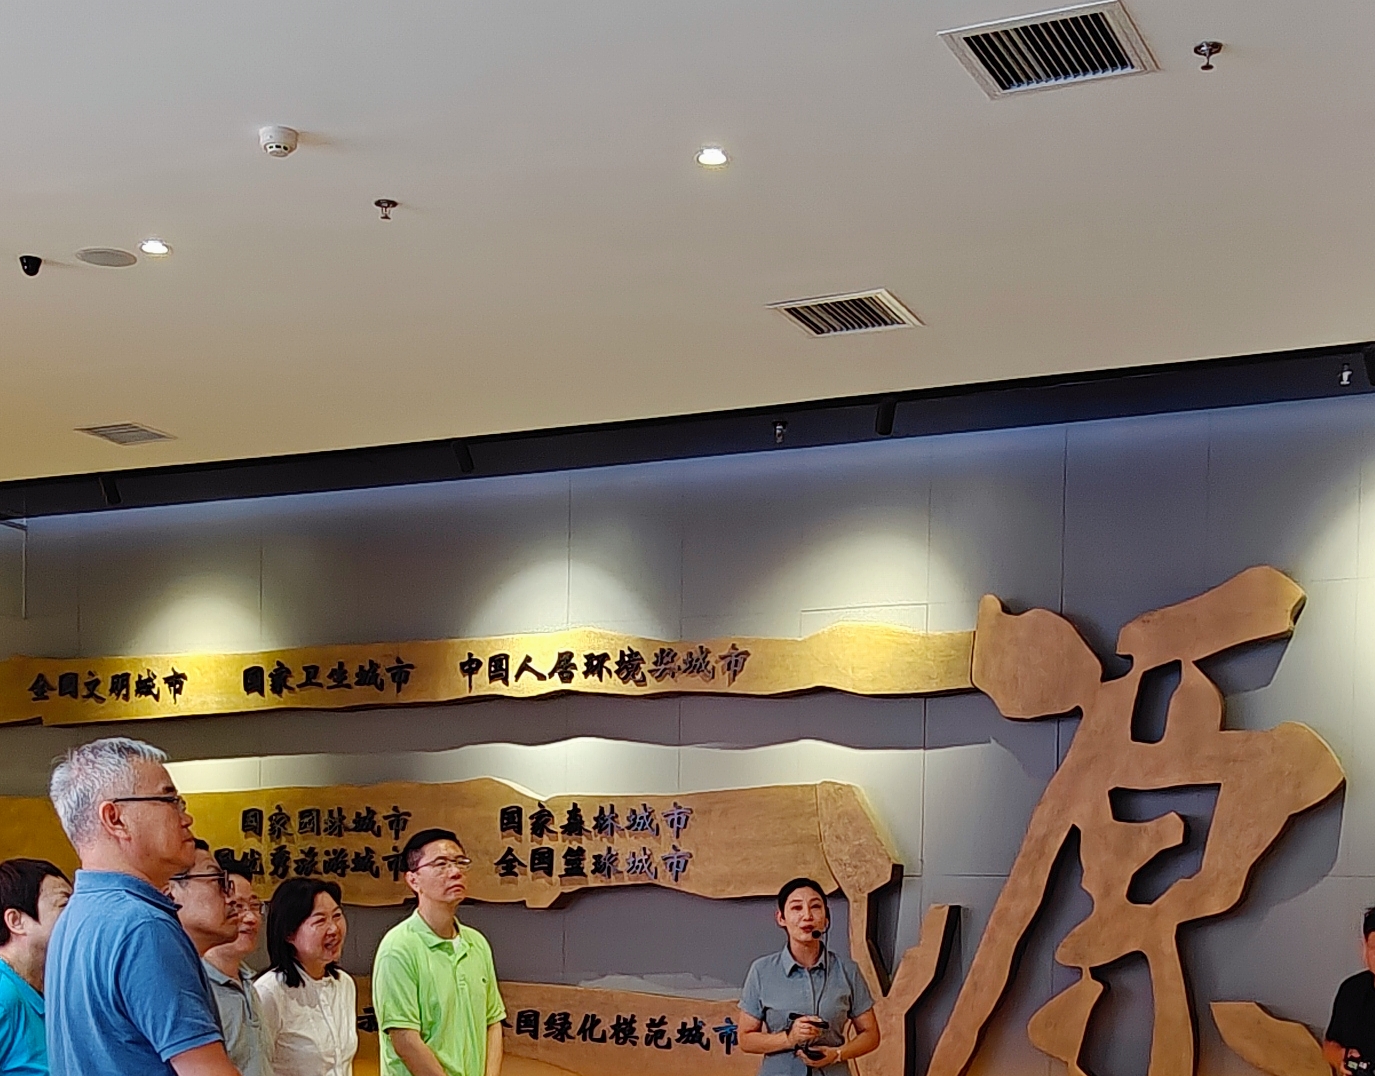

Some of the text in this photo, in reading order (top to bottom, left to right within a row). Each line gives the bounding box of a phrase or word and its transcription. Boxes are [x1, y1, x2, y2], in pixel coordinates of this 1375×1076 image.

[28, 667, 188, 704] 全国文明城市
[242, 656, 416, 697] 国家卫生城市
[241, 802, 694, 841] 国家园林城市 国家森林城市
[494, 845, 693, 883] 全国篮球城市
[501, 1008, 738, 1056] 国绿化模范城市
